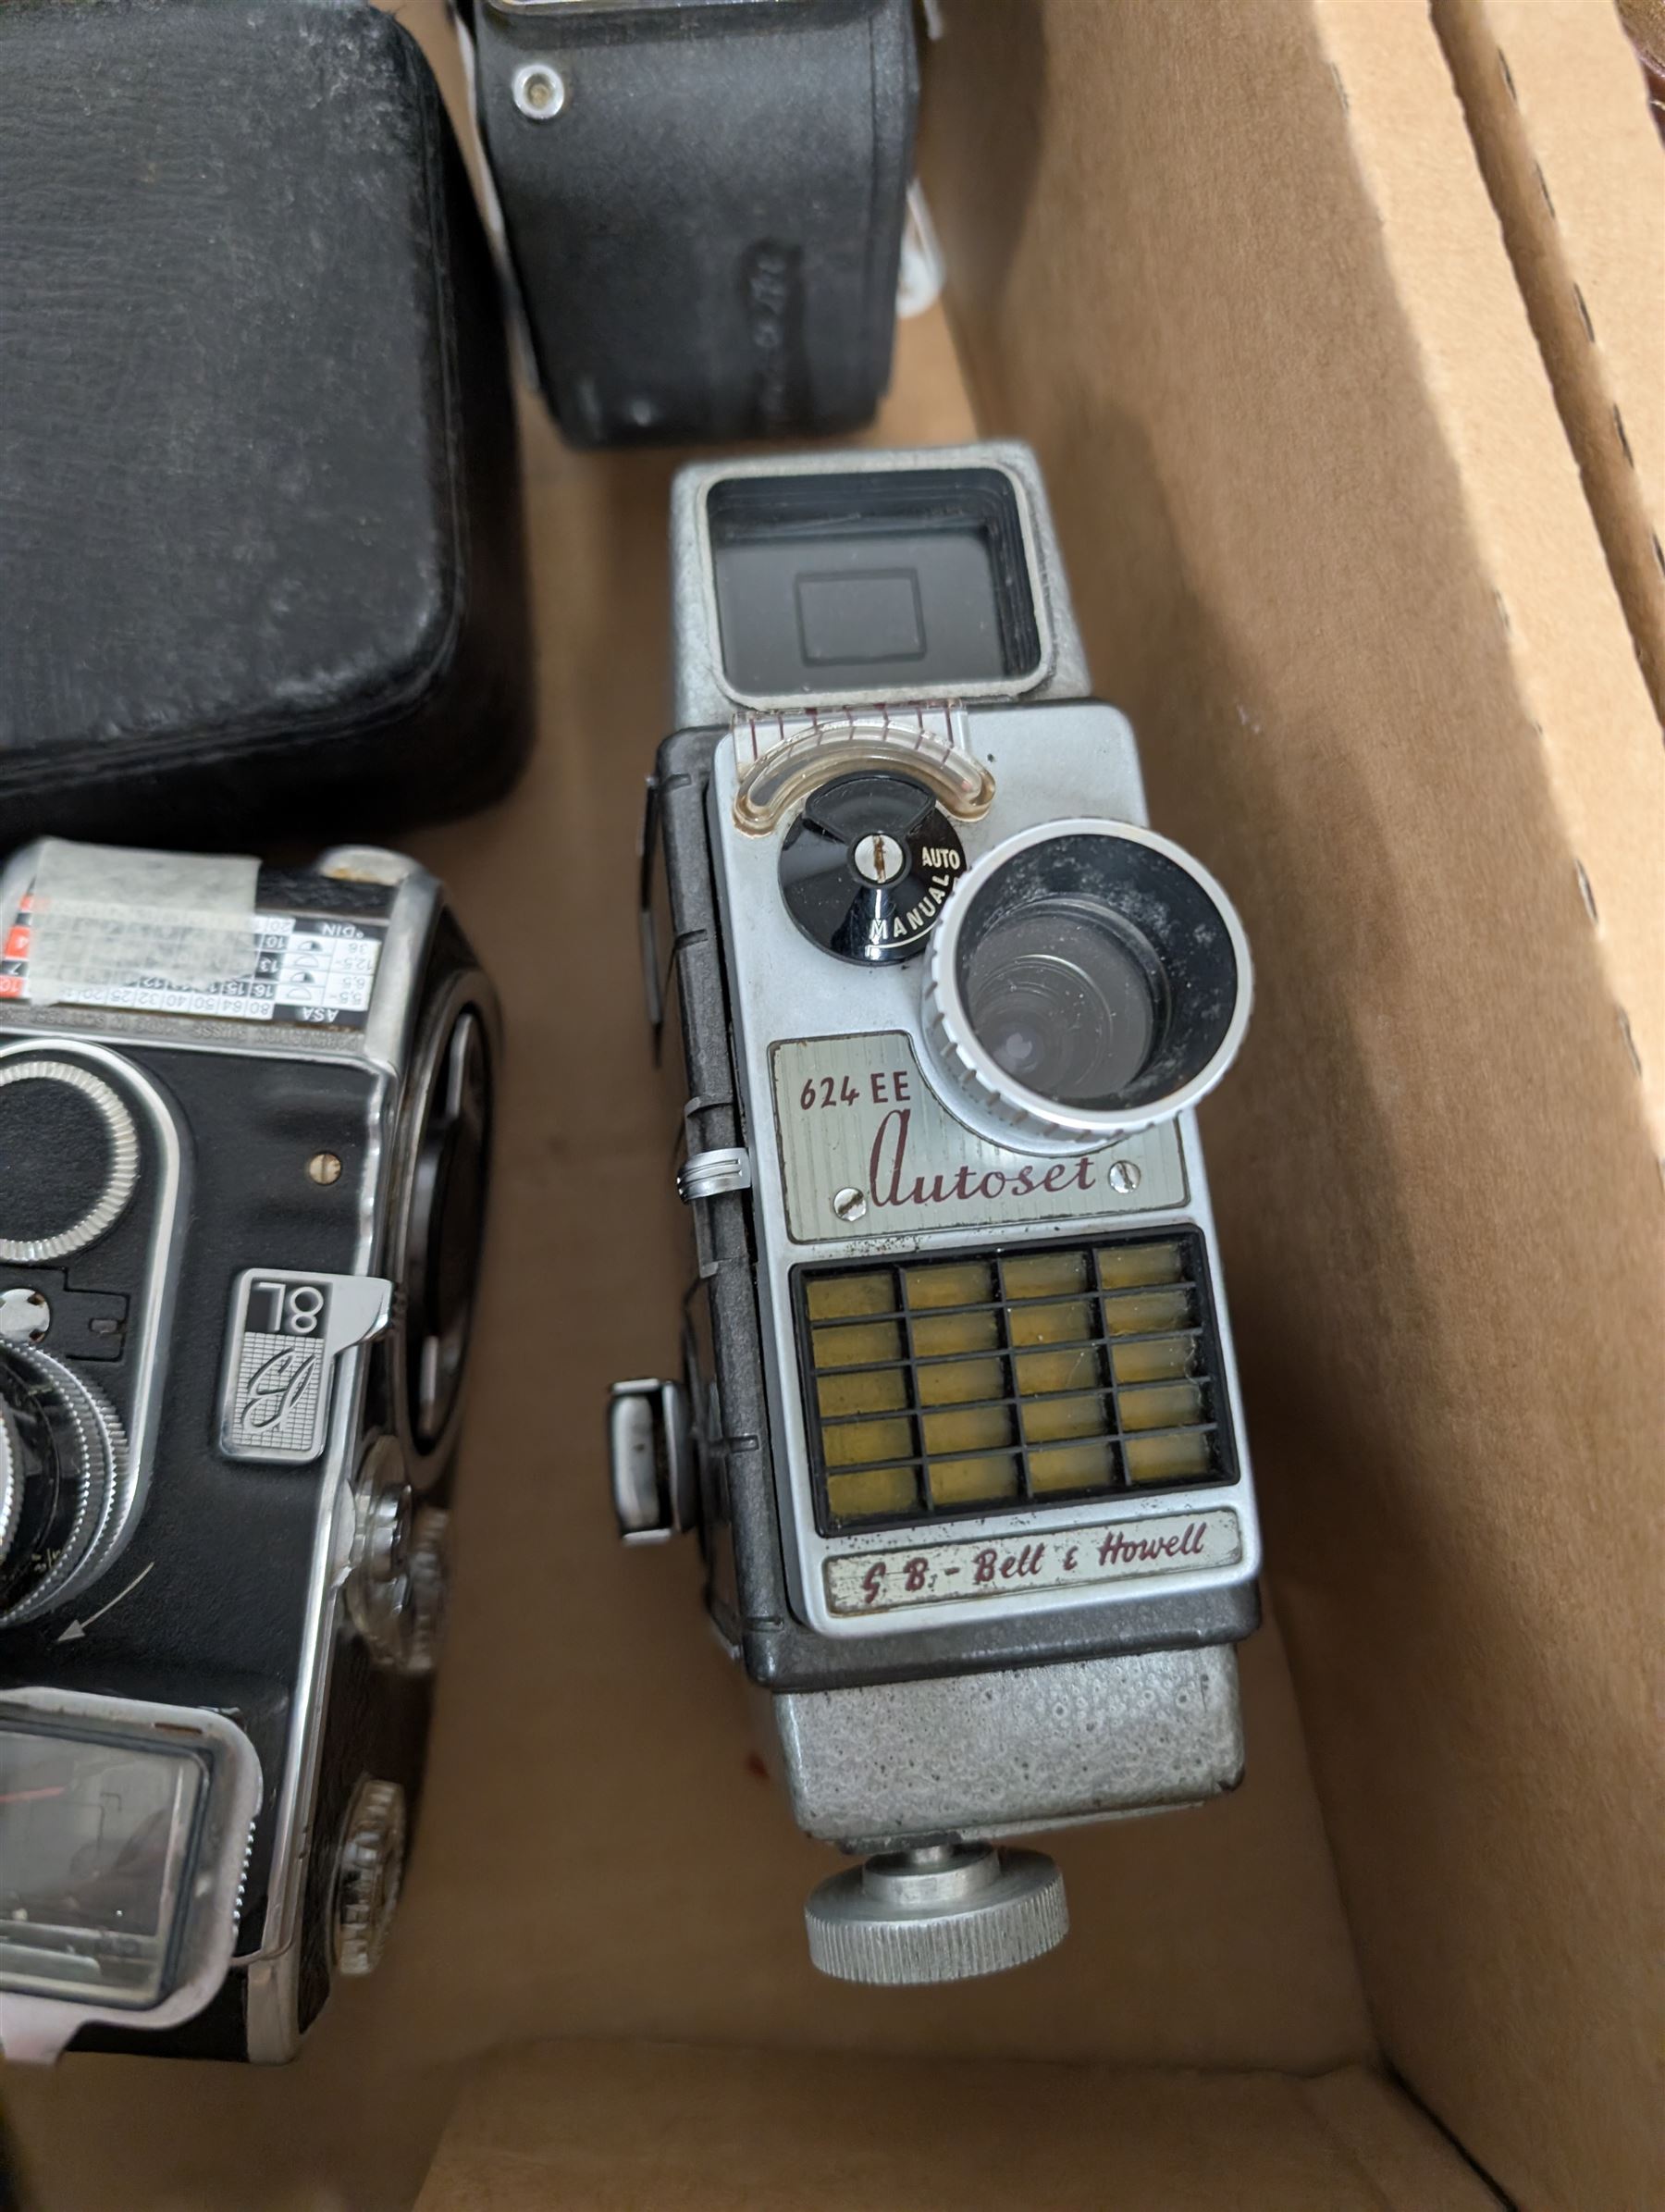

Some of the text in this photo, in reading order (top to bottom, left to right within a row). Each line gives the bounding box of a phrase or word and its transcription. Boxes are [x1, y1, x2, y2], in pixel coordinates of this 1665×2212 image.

[922, 846, 960, 870] AUTO
[869, 874, 950, 941] MANUAL
[265, 935, 288, 948] 10
[8, 962, 22, 976] 7
[260, 957, 279, 974] 13
[111, 989, 131, 1002] 25
[226, 981, 245, 996] 15
[253, 983, 275, 998] 16
[139, 991, 159, 1005] 32
[166, 994, 187, 1007] 40
[194, 996, 216, 1010] 50
[223, 999, 243, 1012] 64
[249, 1001, 270, 1015] 80
[302, 1007, 339, 1022] ASA
[800, 1071, 911, 1110] 624 EE
[870, 1108, 1096, 1207] Autoset
[972, 1542, 1045, 1584] Bell
[1097, 1522, 1206, 1566] Howell
